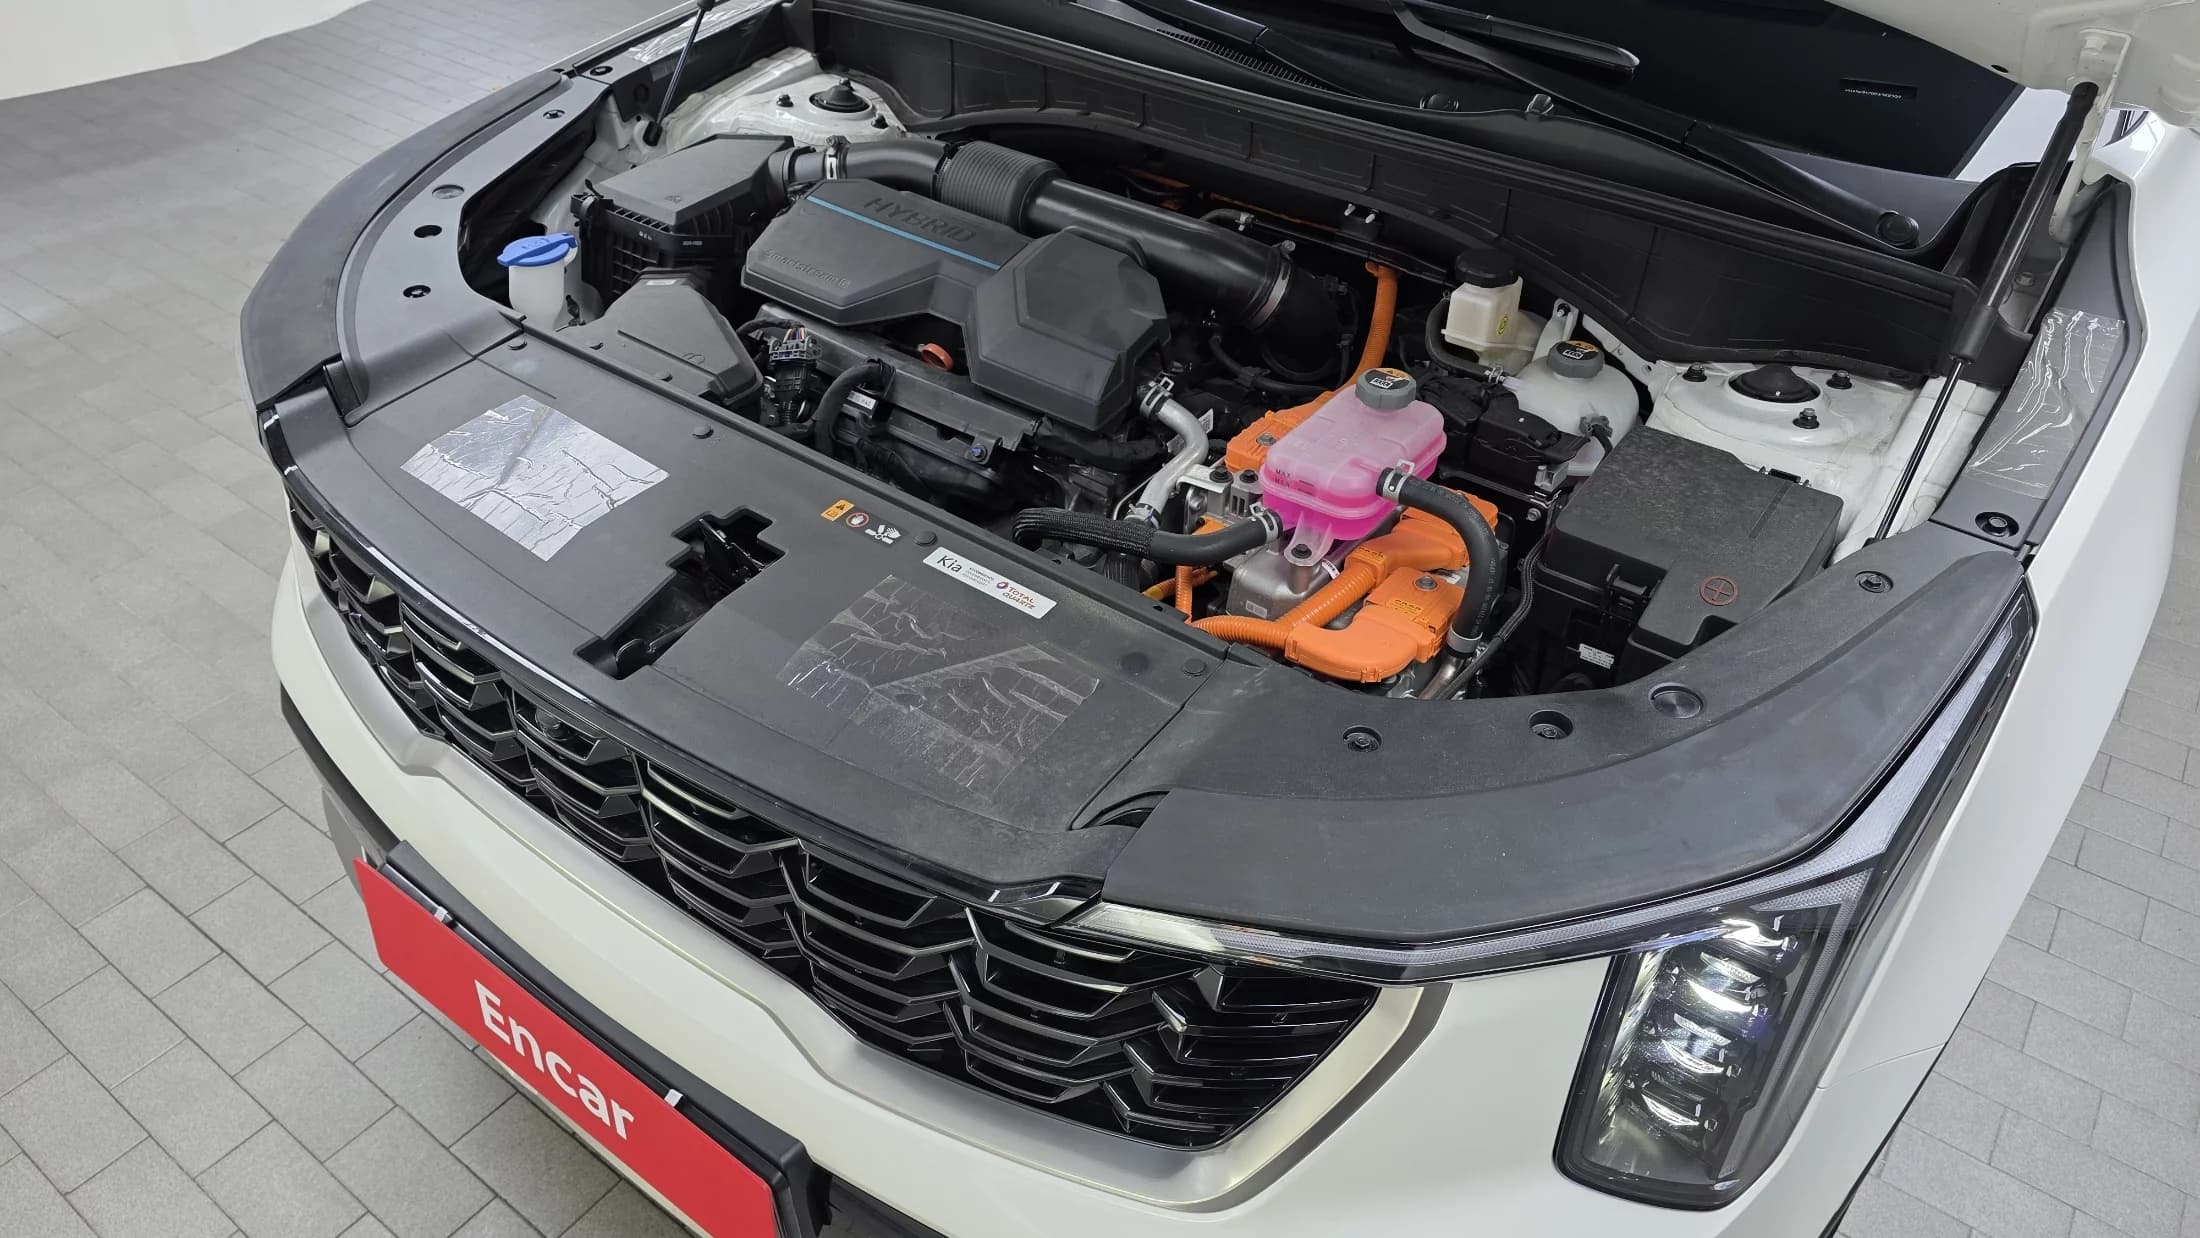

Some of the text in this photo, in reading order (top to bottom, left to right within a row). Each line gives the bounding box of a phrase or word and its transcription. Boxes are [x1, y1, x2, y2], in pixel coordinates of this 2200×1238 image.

[863, 198, 976, 241] HYBRID
[936, 555, 962, 572] Kia
[1002, 592, 1036, 610] QUARTZ
[1008, 586, 1035, 603] TOTAL
[474, 979, 635, 1141] Encar
